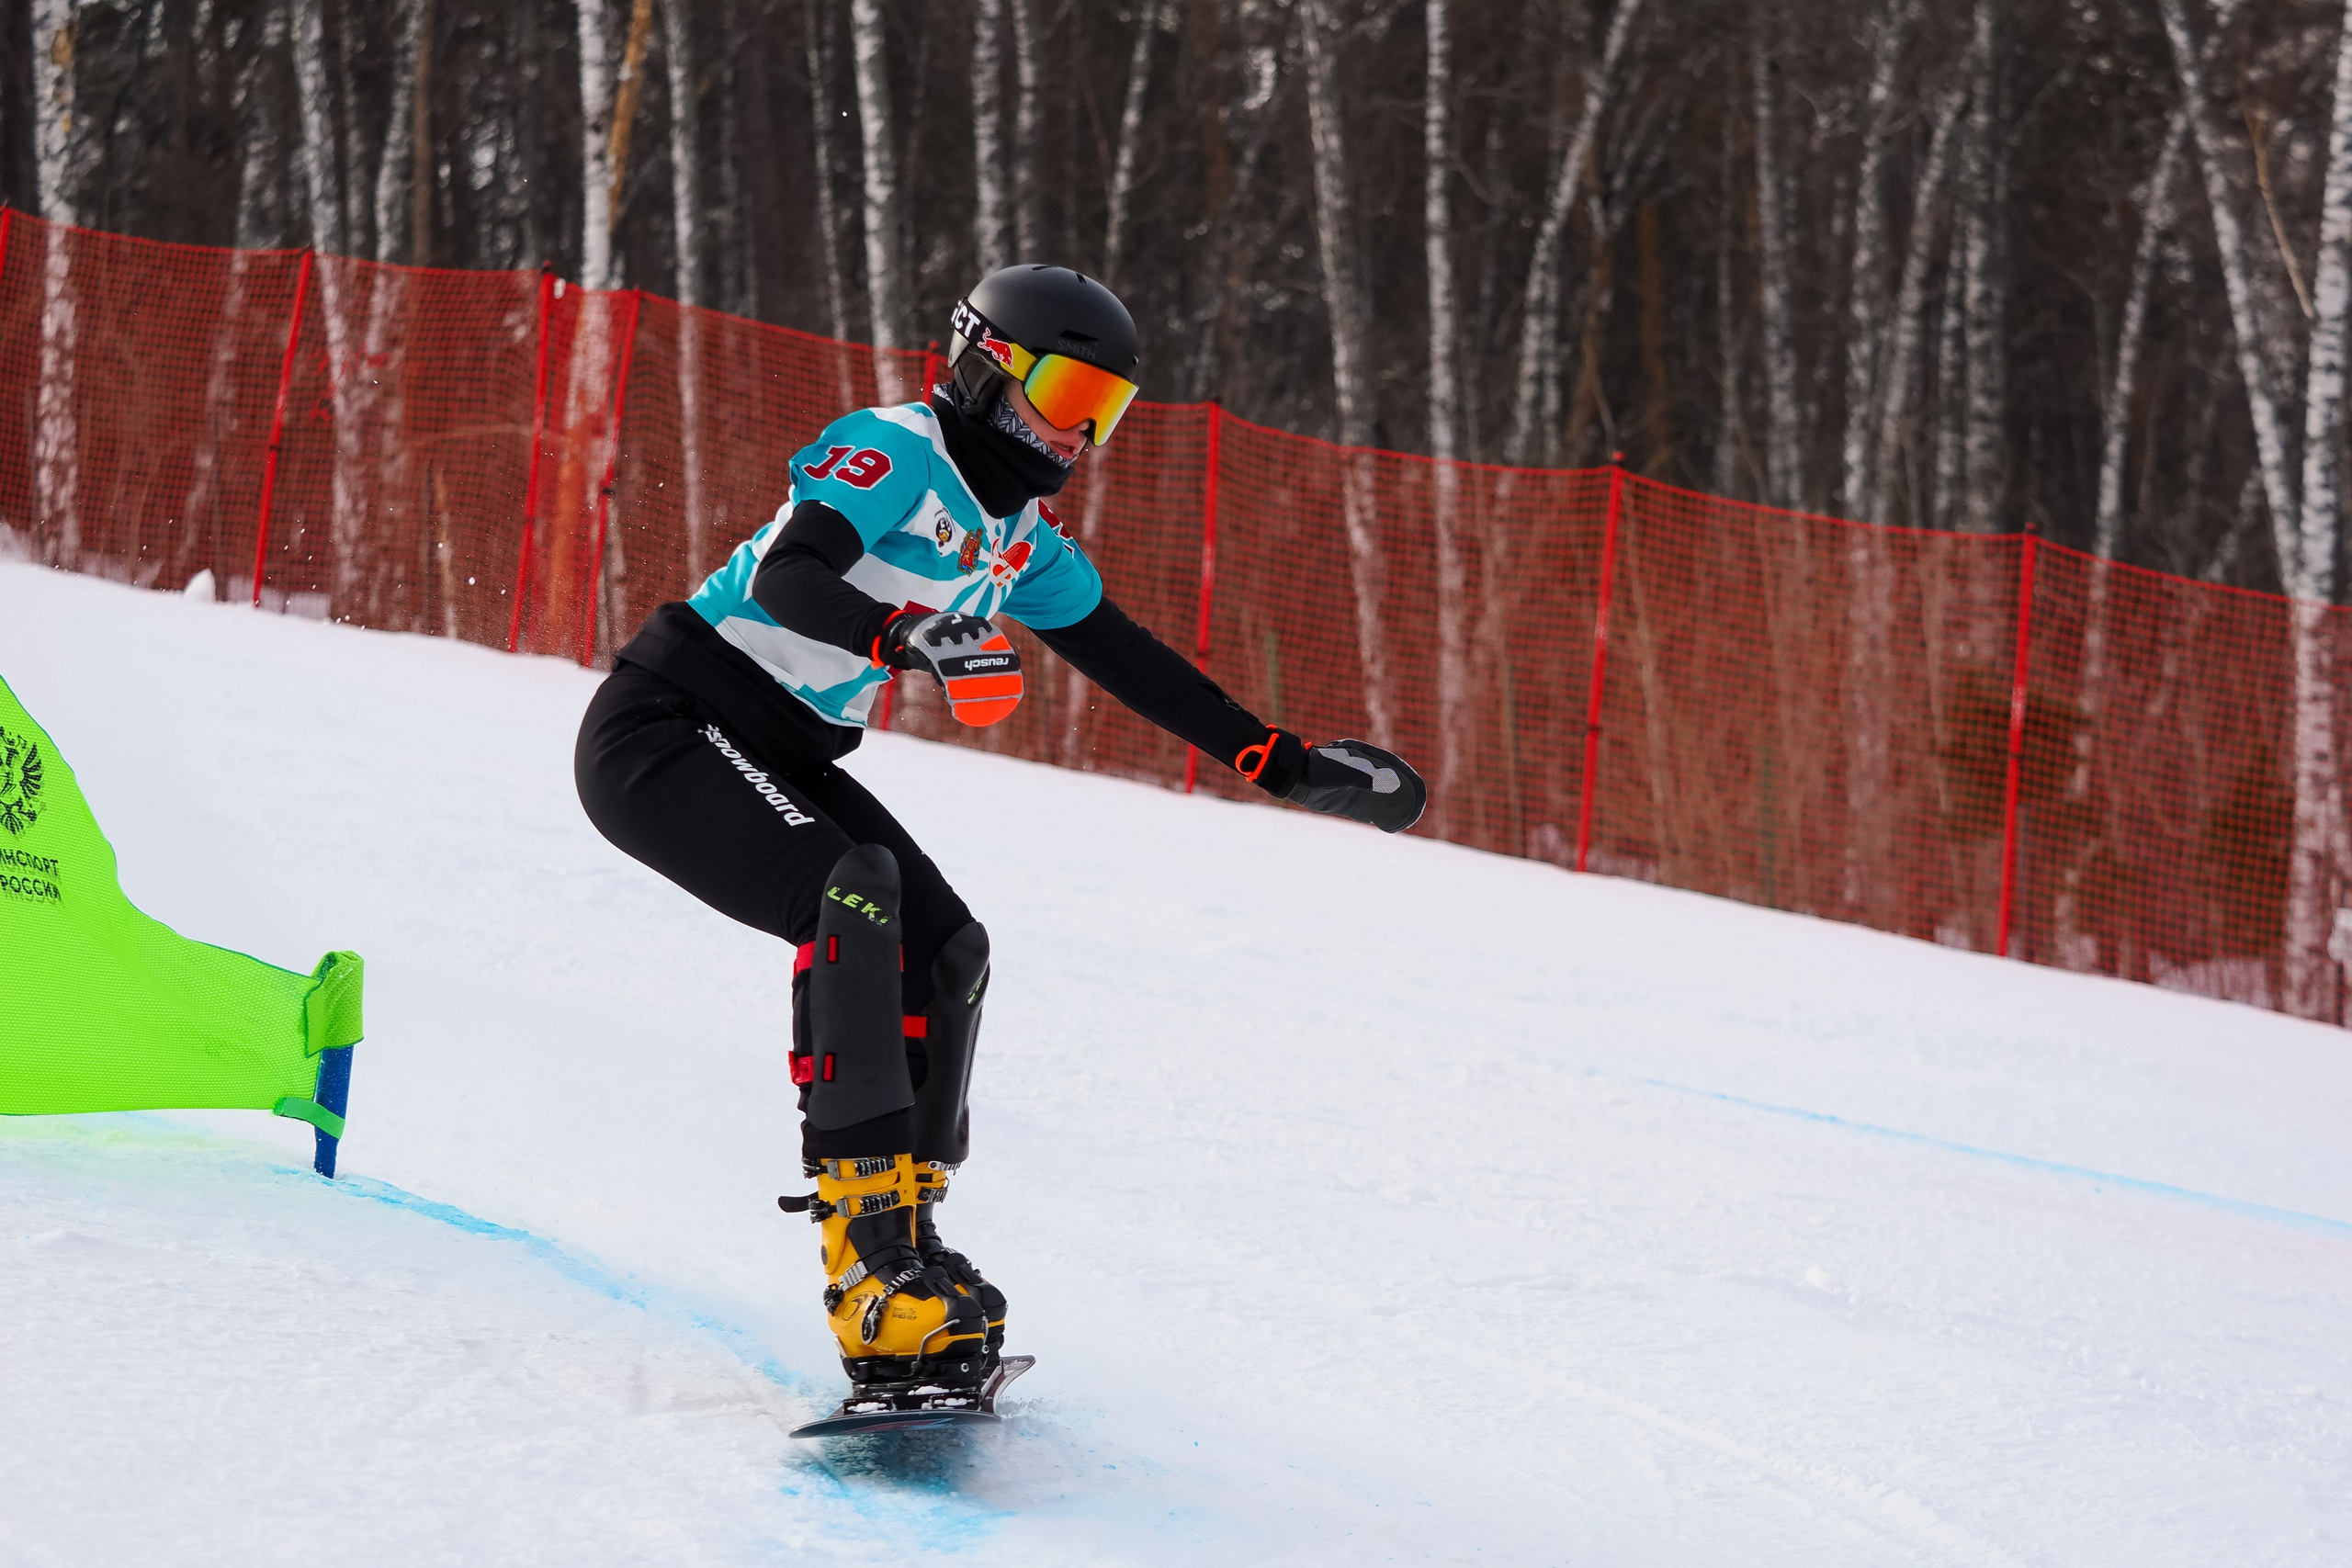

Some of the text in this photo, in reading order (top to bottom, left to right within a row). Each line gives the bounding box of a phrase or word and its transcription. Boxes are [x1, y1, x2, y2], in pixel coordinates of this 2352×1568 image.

[1057, 340, 1097, 359] SMITH
[801, 445, 894, 491] 19
[965, 657, 1010, 671] reusch
[704, 730, 816, 827] snowboard
